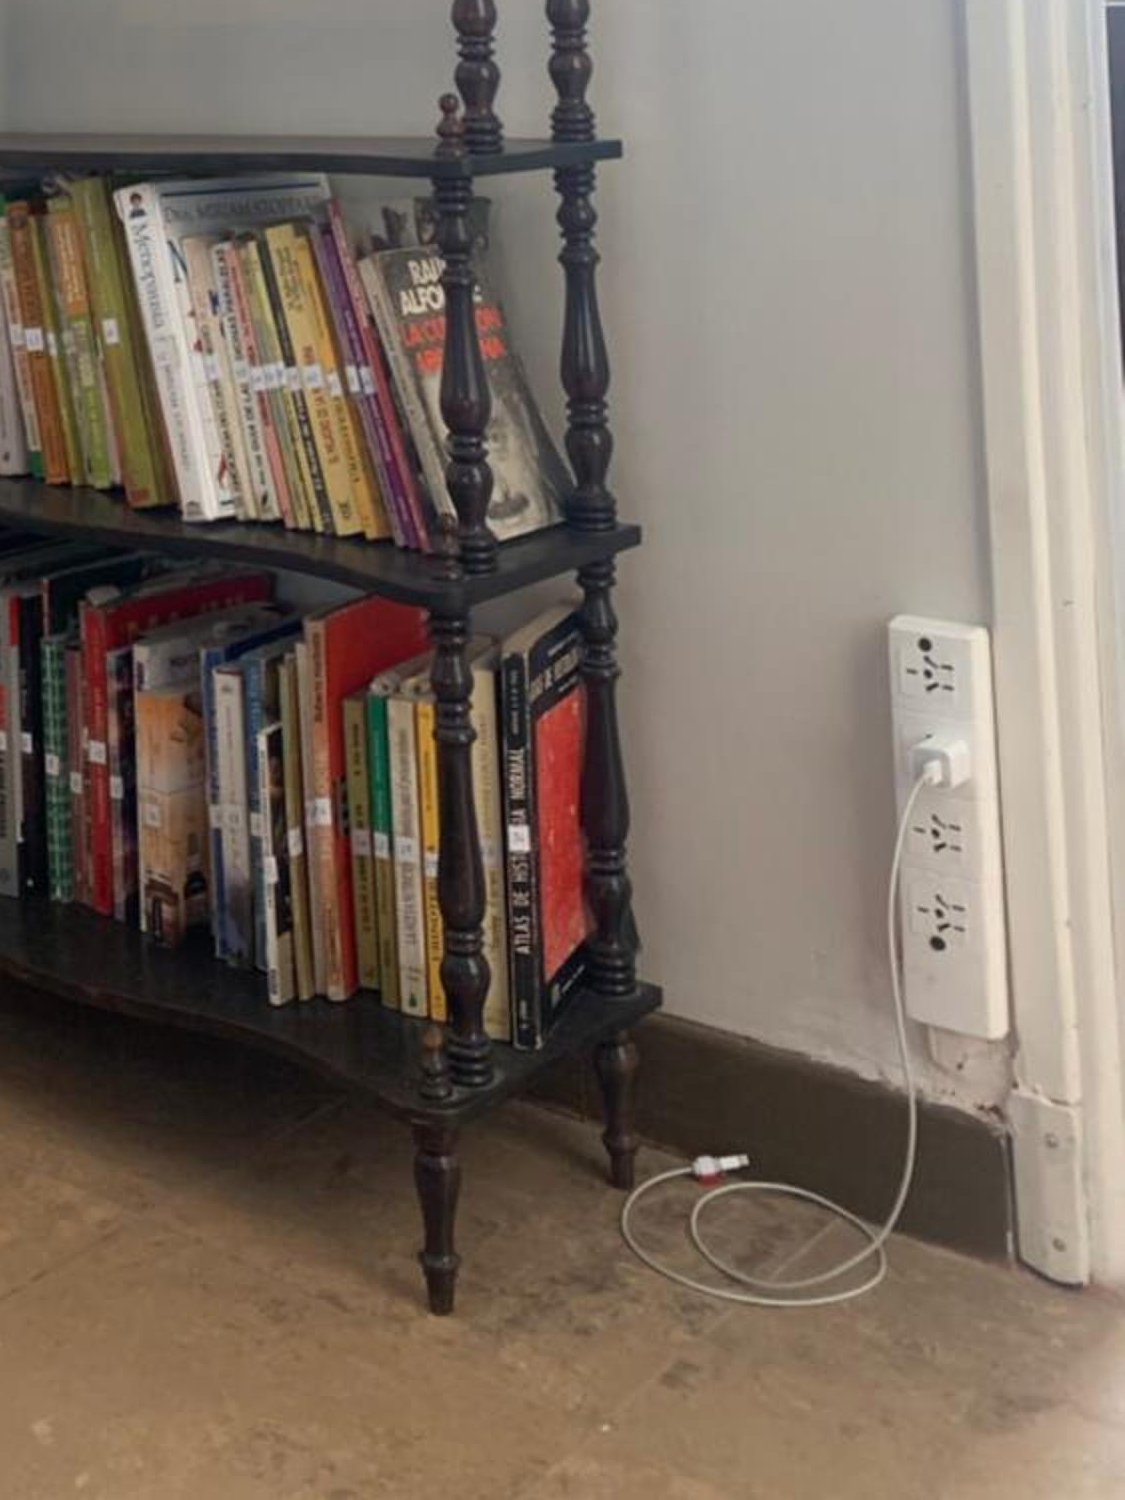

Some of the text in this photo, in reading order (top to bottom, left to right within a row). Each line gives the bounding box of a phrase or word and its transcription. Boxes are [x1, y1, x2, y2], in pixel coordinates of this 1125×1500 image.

[507, 747, 526, 800] NORMAL
[513, 887, 530, 906] DE
[512, 915, 531, 955] ATLAS
